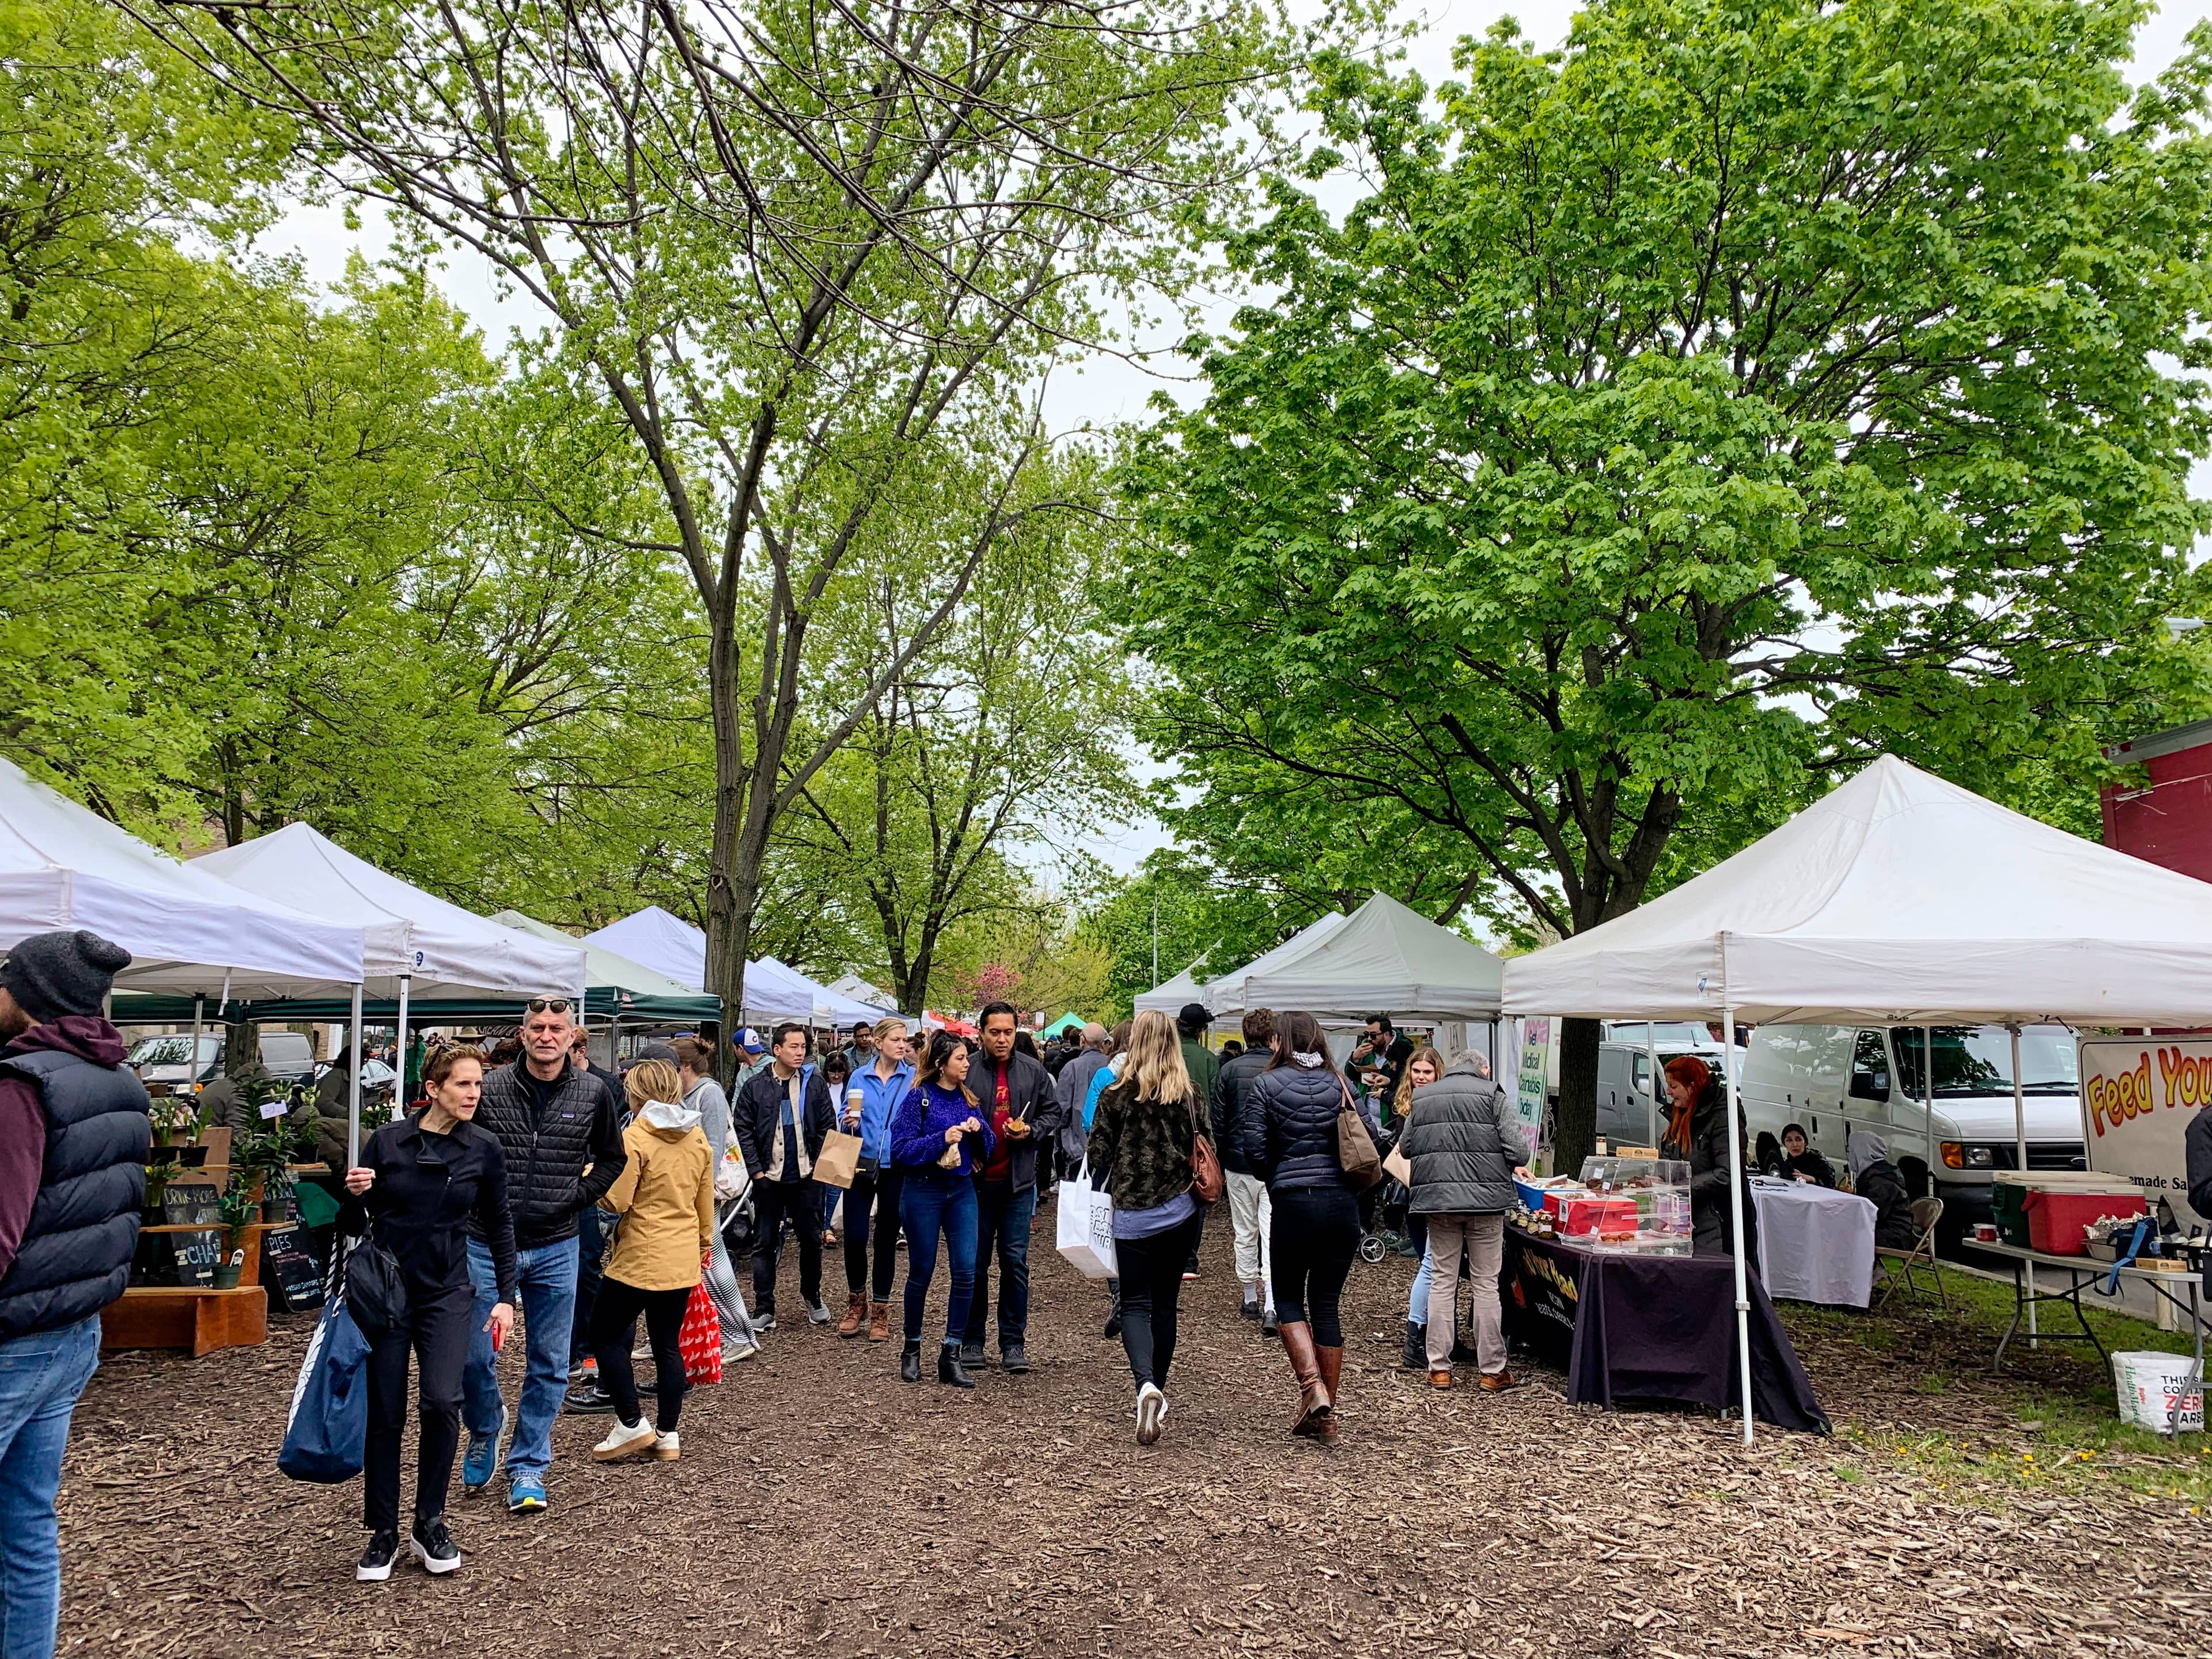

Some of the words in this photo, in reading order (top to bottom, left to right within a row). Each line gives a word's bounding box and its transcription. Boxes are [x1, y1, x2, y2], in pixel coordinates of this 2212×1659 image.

[2088, 1051, 2153, 1138] Feed
[2116, 1173, 2167, 1190] emade
[2172, 1177, 2187, 1191] Sa
[164, 1188, 191, 1205] DRINK
[268, 1235, 292, 1250] PIES
[2164, 1395, 2203, 1411] ZER
